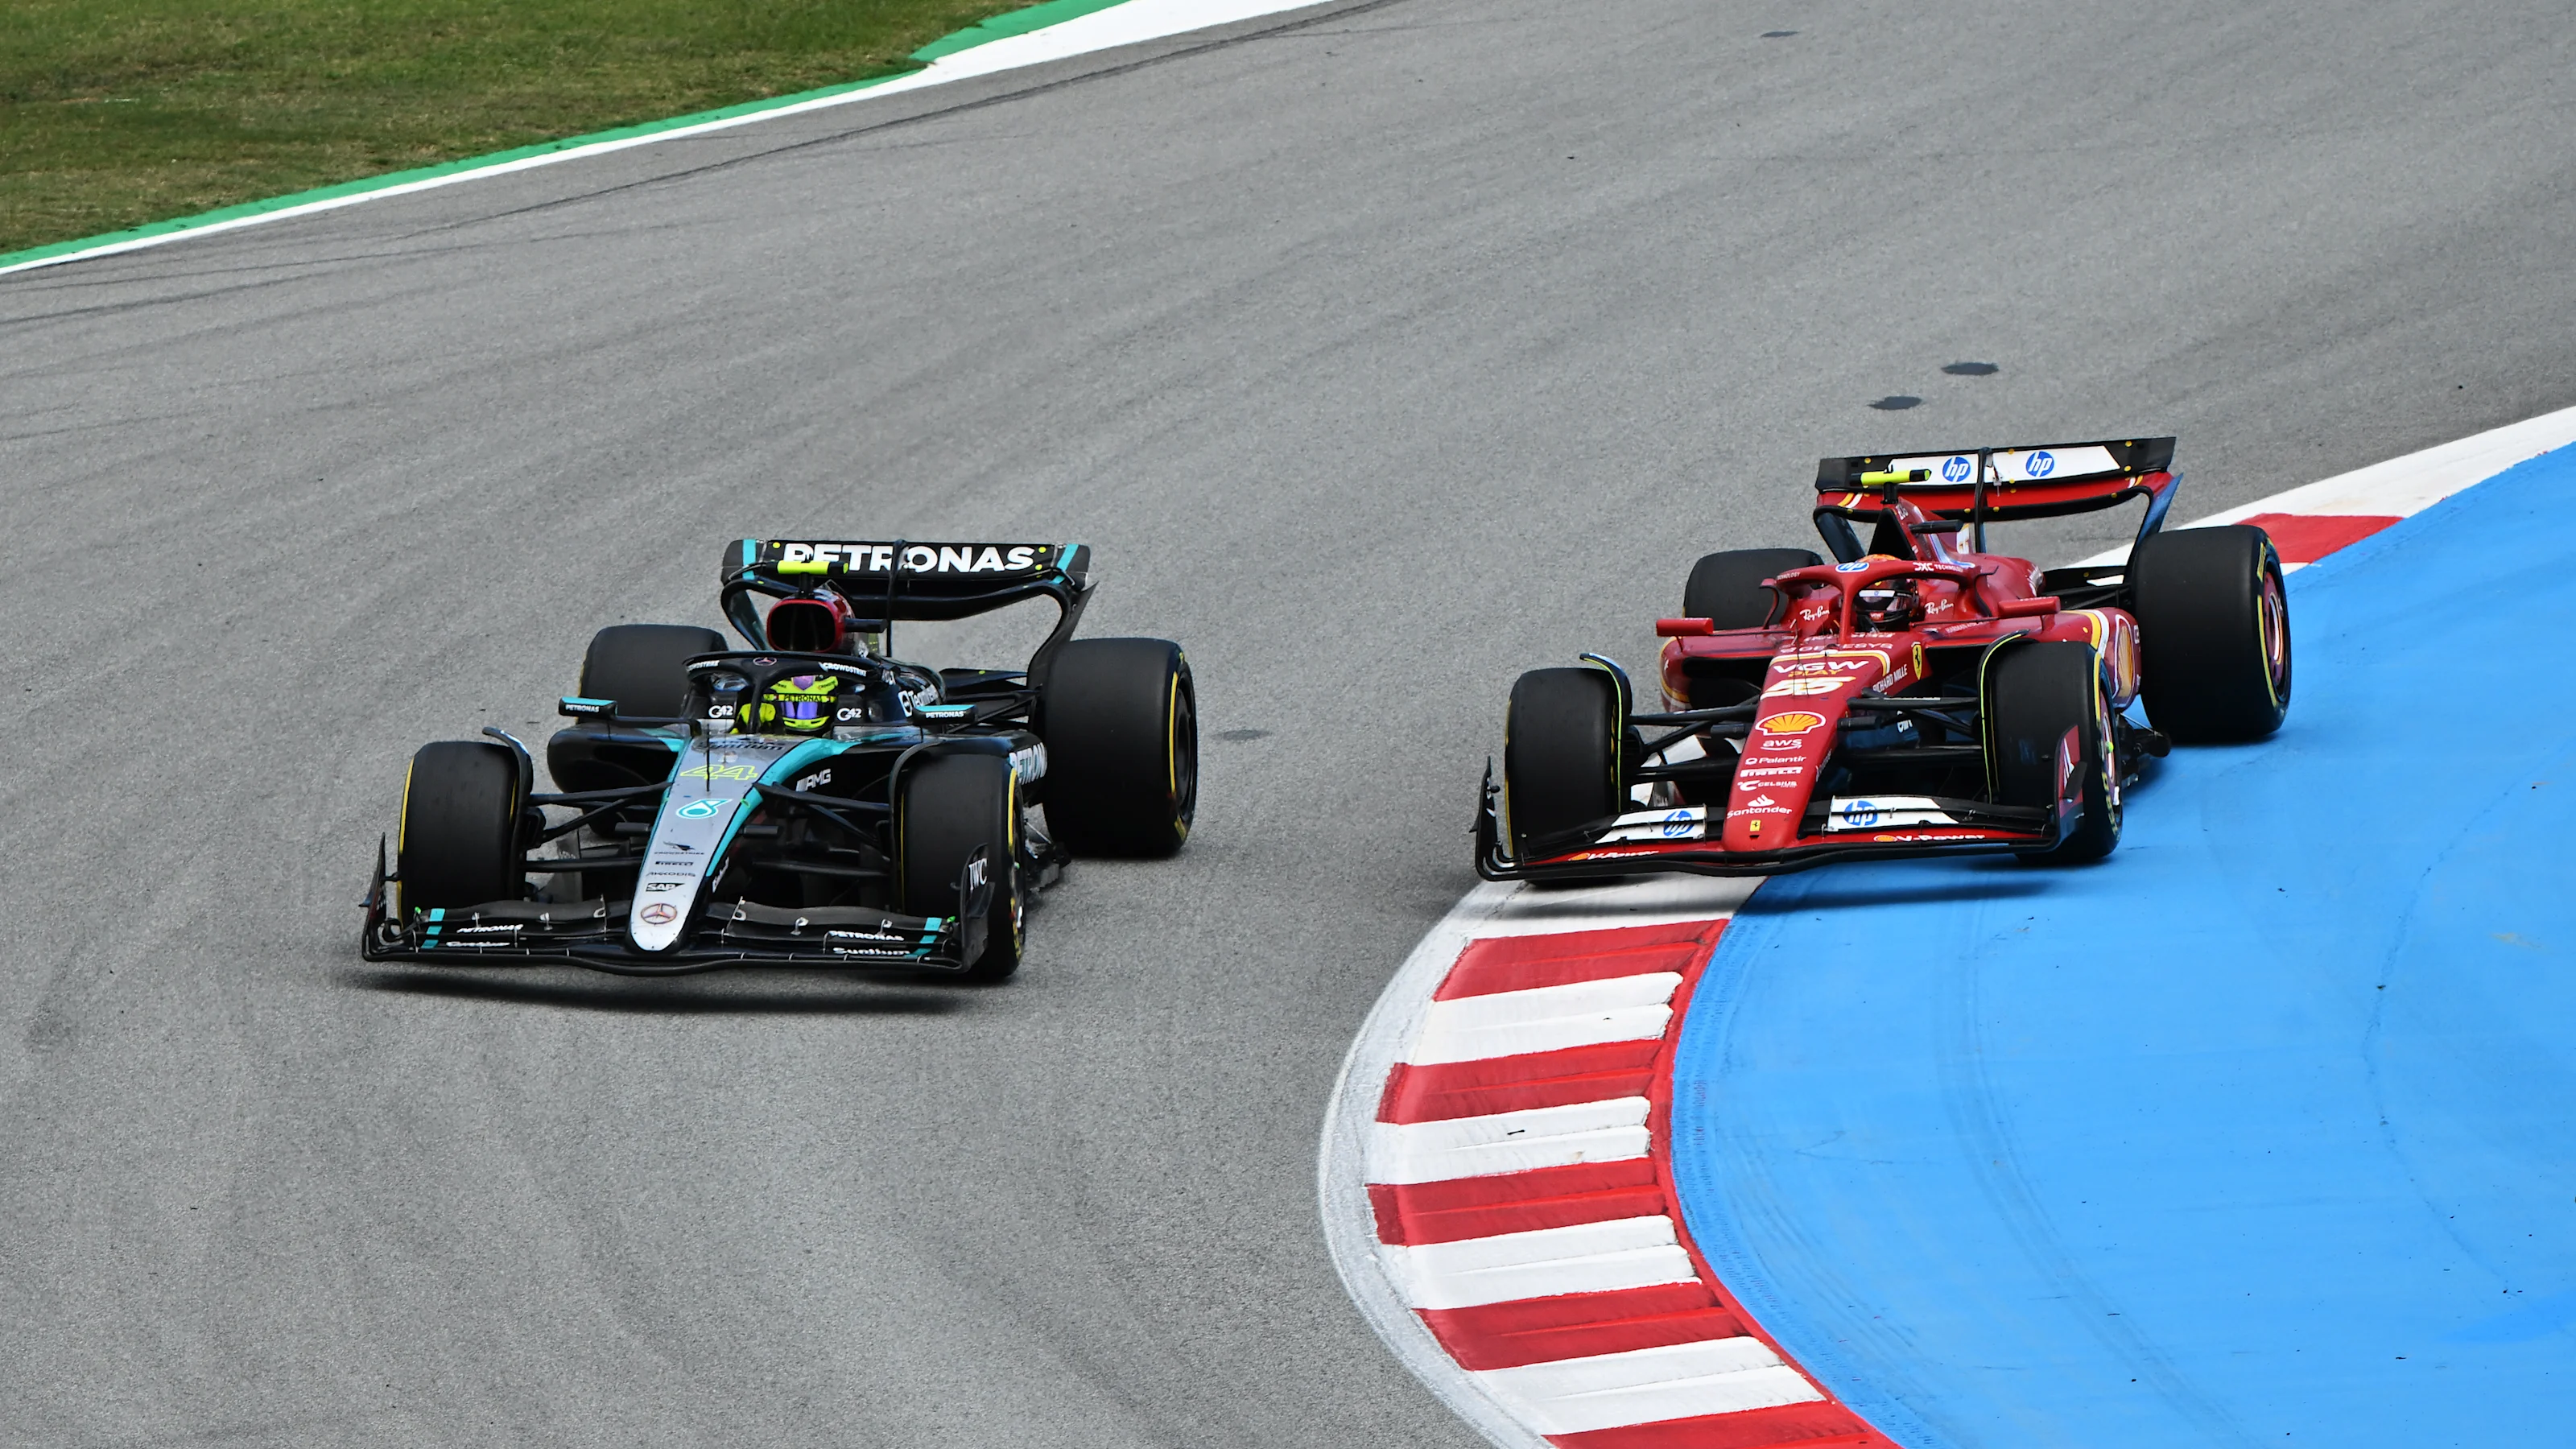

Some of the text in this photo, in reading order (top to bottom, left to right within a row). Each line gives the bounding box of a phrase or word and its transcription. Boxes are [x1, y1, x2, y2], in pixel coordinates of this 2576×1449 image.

[1942, 456, 1971, 482] hp
[2027, 452, 2054, 477] hp
[783, 543, 1036, 573] PETRONAS
[1773, 661, 1869, 674] VGW
[1760, 675, 1857, 700] 55
[565, 704, 600, 713] PETRONAS
[708, 705, 733, 718] G42
[837, 708, 862, 721] G42
[926, 711, 965, 719] PETRONAS
[1763, 738, 1802, 747] aws
[1759, 755, 1807, 765] Palantir
[680, 764, 758, 781] 44
[1740, 766, 1803, 778] PIRELLI
[1726, 806, 1793, 819] Santander
[646, 883, 678, 891] SAP
